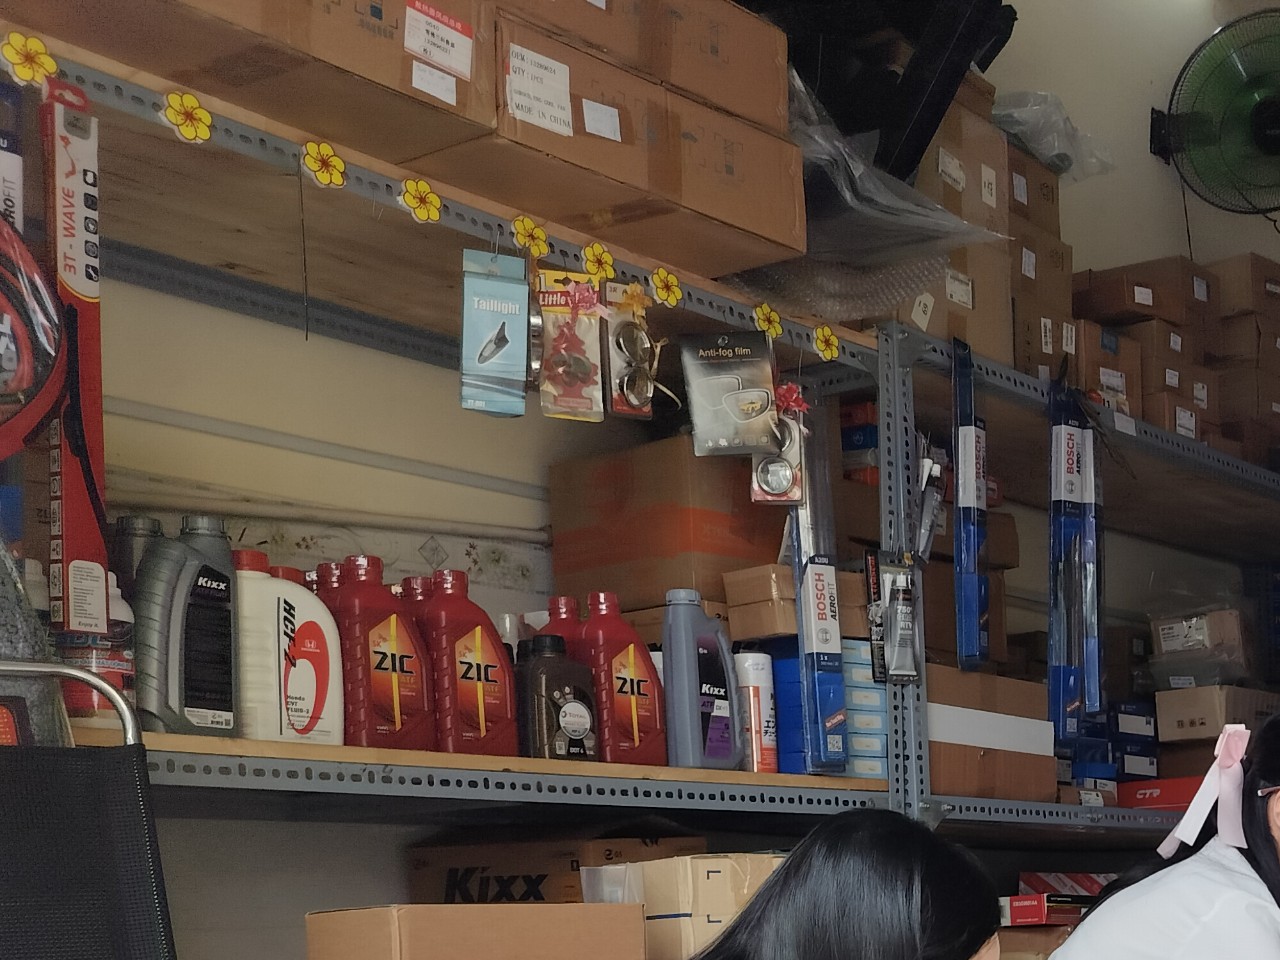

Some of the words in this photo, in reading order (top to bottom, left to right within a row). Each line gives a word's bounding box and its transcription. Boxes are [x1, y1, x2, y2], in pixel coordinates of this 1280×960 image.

[514, 102, 532, 116] MADE
[538, 110, 547, 120] IN
[549, 114, 571, 130] CHINA
[61, 186, 77, 239] WAVE
[62, 252, 77, 276] 3T
[472, 297, 521, 316] Taillight
[539, 294, 567, 307] Little
[698, 348, 730, 359] Anti-fog
[731, 346, 752, 357] film
[974, 434, 982, 480] BOSCH
[1066, 432, 1075, 475] BOSCH
[197, 576, 227, 591] Kixx
[814, 572, 828, 621] BOSCH
[828, 581, 838, 622] AEROFIT
[373, 650, 416, 675] ZIC
[459, 660, 500, 683] ZIC
[615, 676, 649, 697] ZIC
[701, 684, 726, 696] Kixx
[1136, 788, 1161, 799] CTR
[444, 866, 549, 905] Kixx
